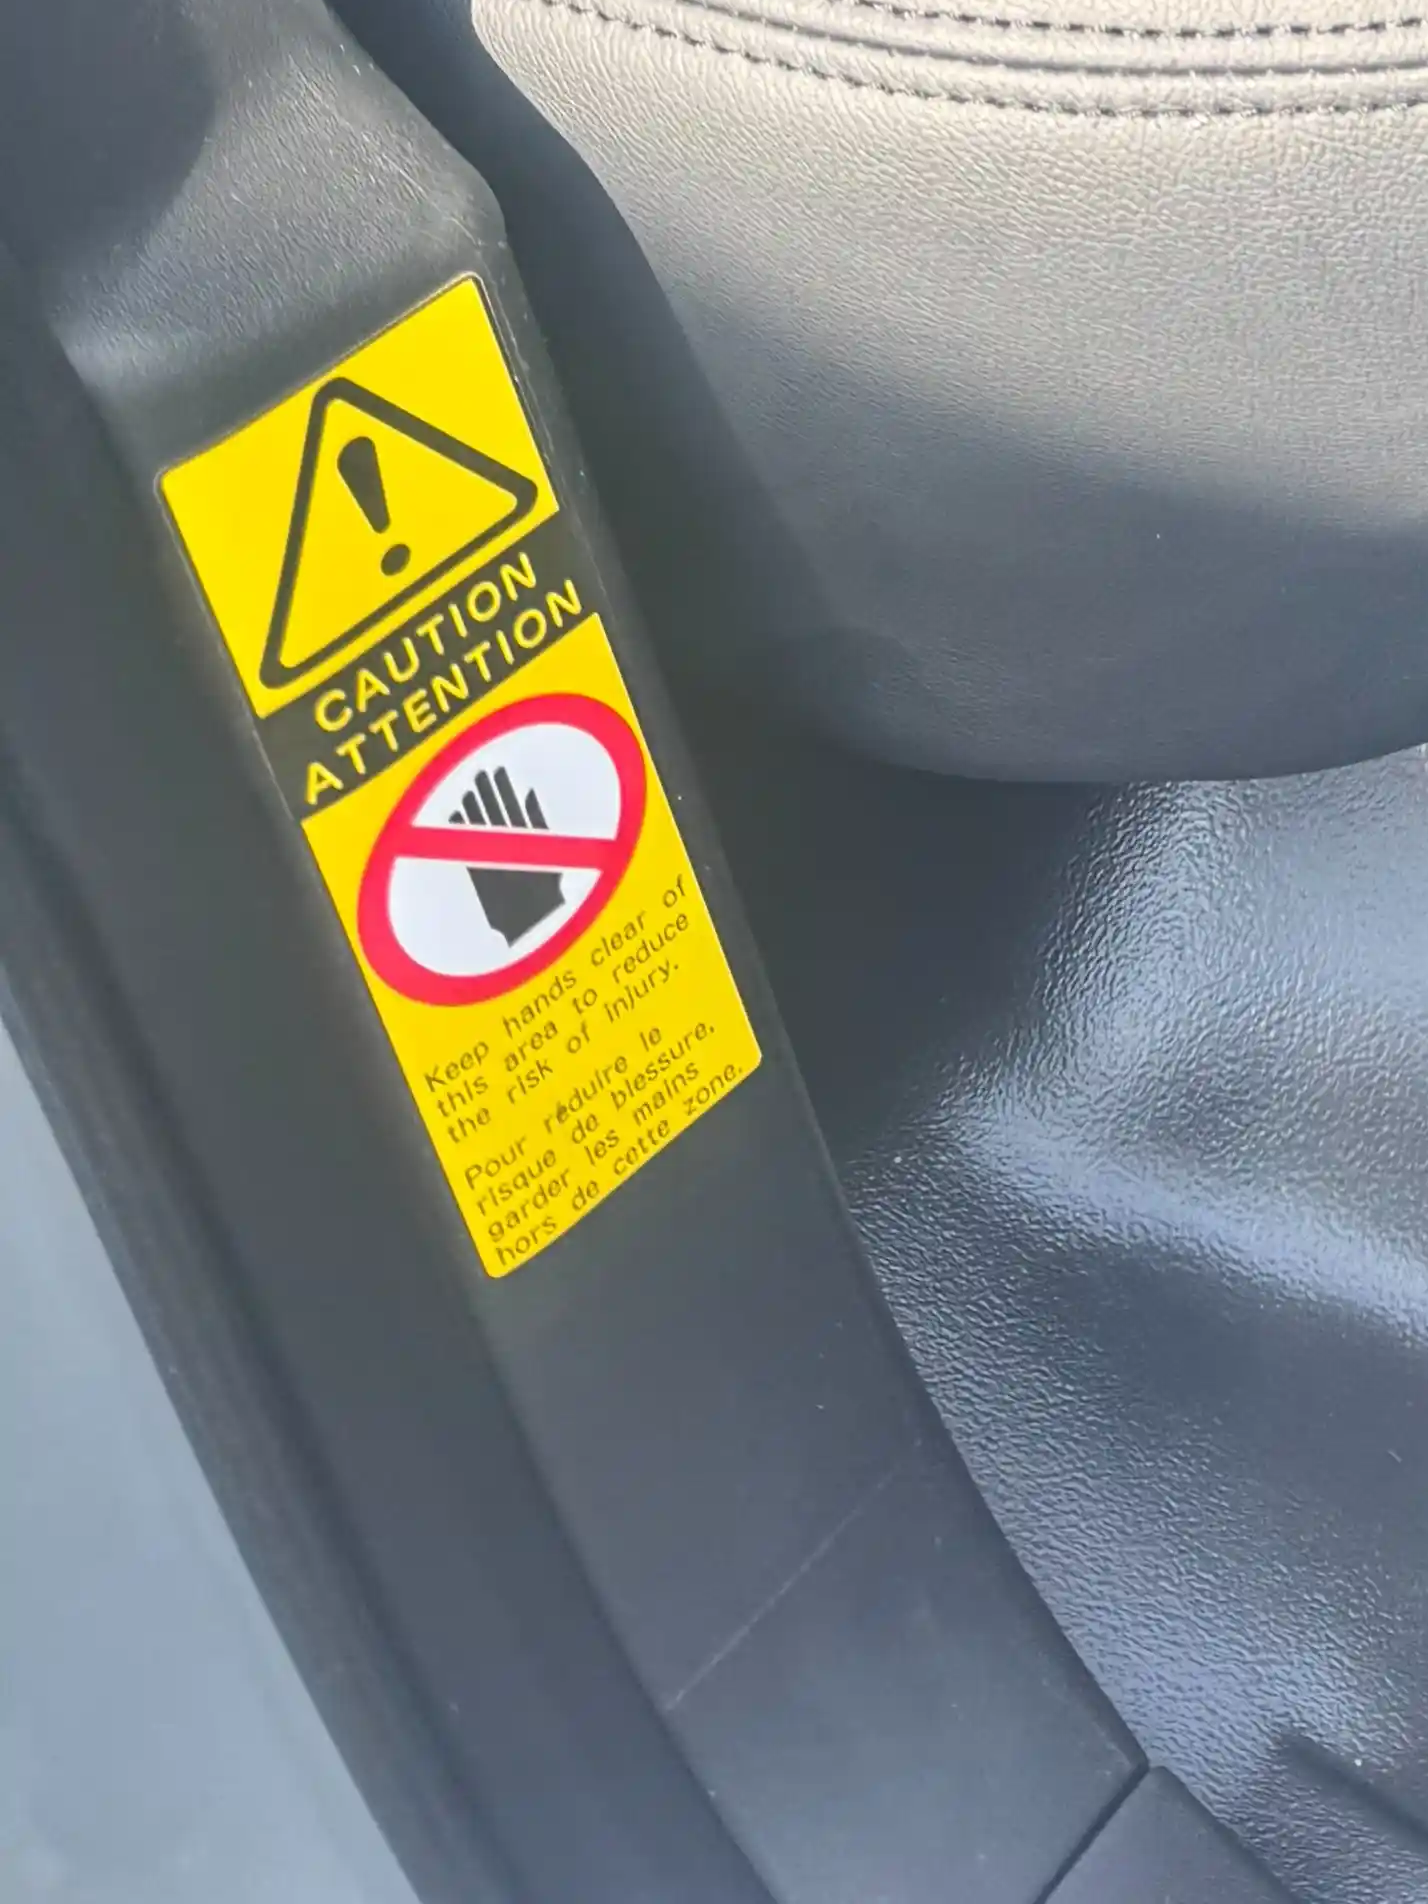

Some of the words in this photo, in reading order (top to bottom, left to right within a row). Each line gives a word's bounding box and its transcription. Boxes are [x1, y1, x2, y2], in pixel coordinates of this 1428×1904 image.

[306, 579, 582, 805] ATTENTION
[315, 552, 536, 731] CAUTION
[423, 1041, 489, 1093] Keep
[502, 969, 577, 1039] hands
[590, 911, 648, 967] clear
[662, 874, 685, 908] of
[436, 1075, 489, 1118] this
[504, 1020, 558, 1072] area
[572, 988, 598, 1015] to
[612, 913, 689, 984] reduce
[447, 1107, 491, 1144] the
[506, 1059, 553, 1105] risk
[566, 1022, 591, 1054] of
[604, 959, 679, 1023] injury.
[464, 1135, 527, 1191] Pour
[544, 1055, 628, 1134] réduire
[639, 1026, 662, 1053] le
[477, 1149, 556, 1216] risque
[571, 1113, 600, 1145] de
[488, 1167, 570, 1242] garder
[583, 1128, 620, 1167] les
[632, 1062, 699, 1126] mains
[496, 1216, 557, 1266] hors
[572, 1180, 599, 1211] de
[613, 1119, 670, 1176] cette
[683, 1064, 743, 1116] zone.
